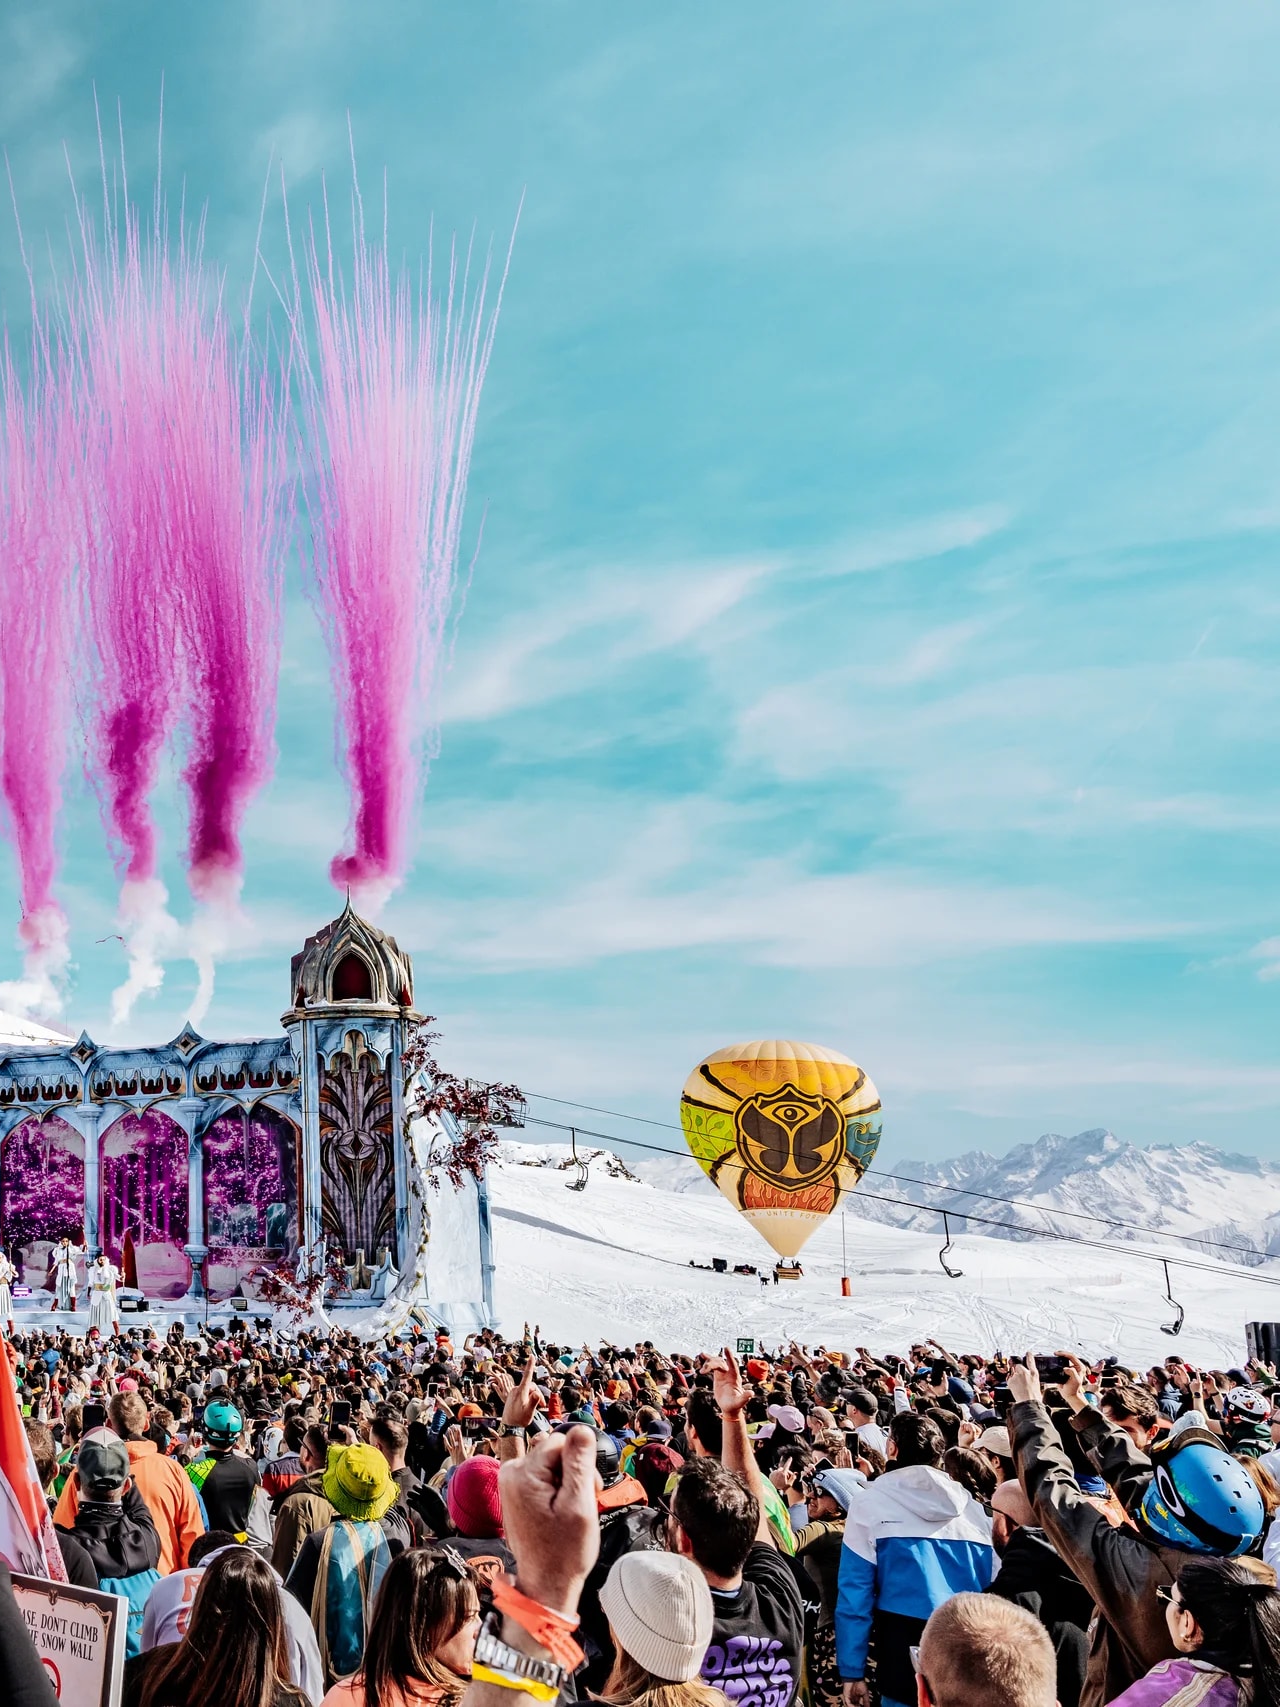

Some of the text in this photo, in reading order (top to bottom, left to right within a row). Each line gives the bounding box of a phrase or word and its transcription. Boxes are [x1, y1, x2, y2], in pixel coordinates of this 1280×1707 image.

[40, 1613, 68, 1635] DON'T
[70, 1621, 99, 1643] CLIMB
[41, 1632, 67, 1653] SNOW
[70, 1640, 94, 1662] WALL
